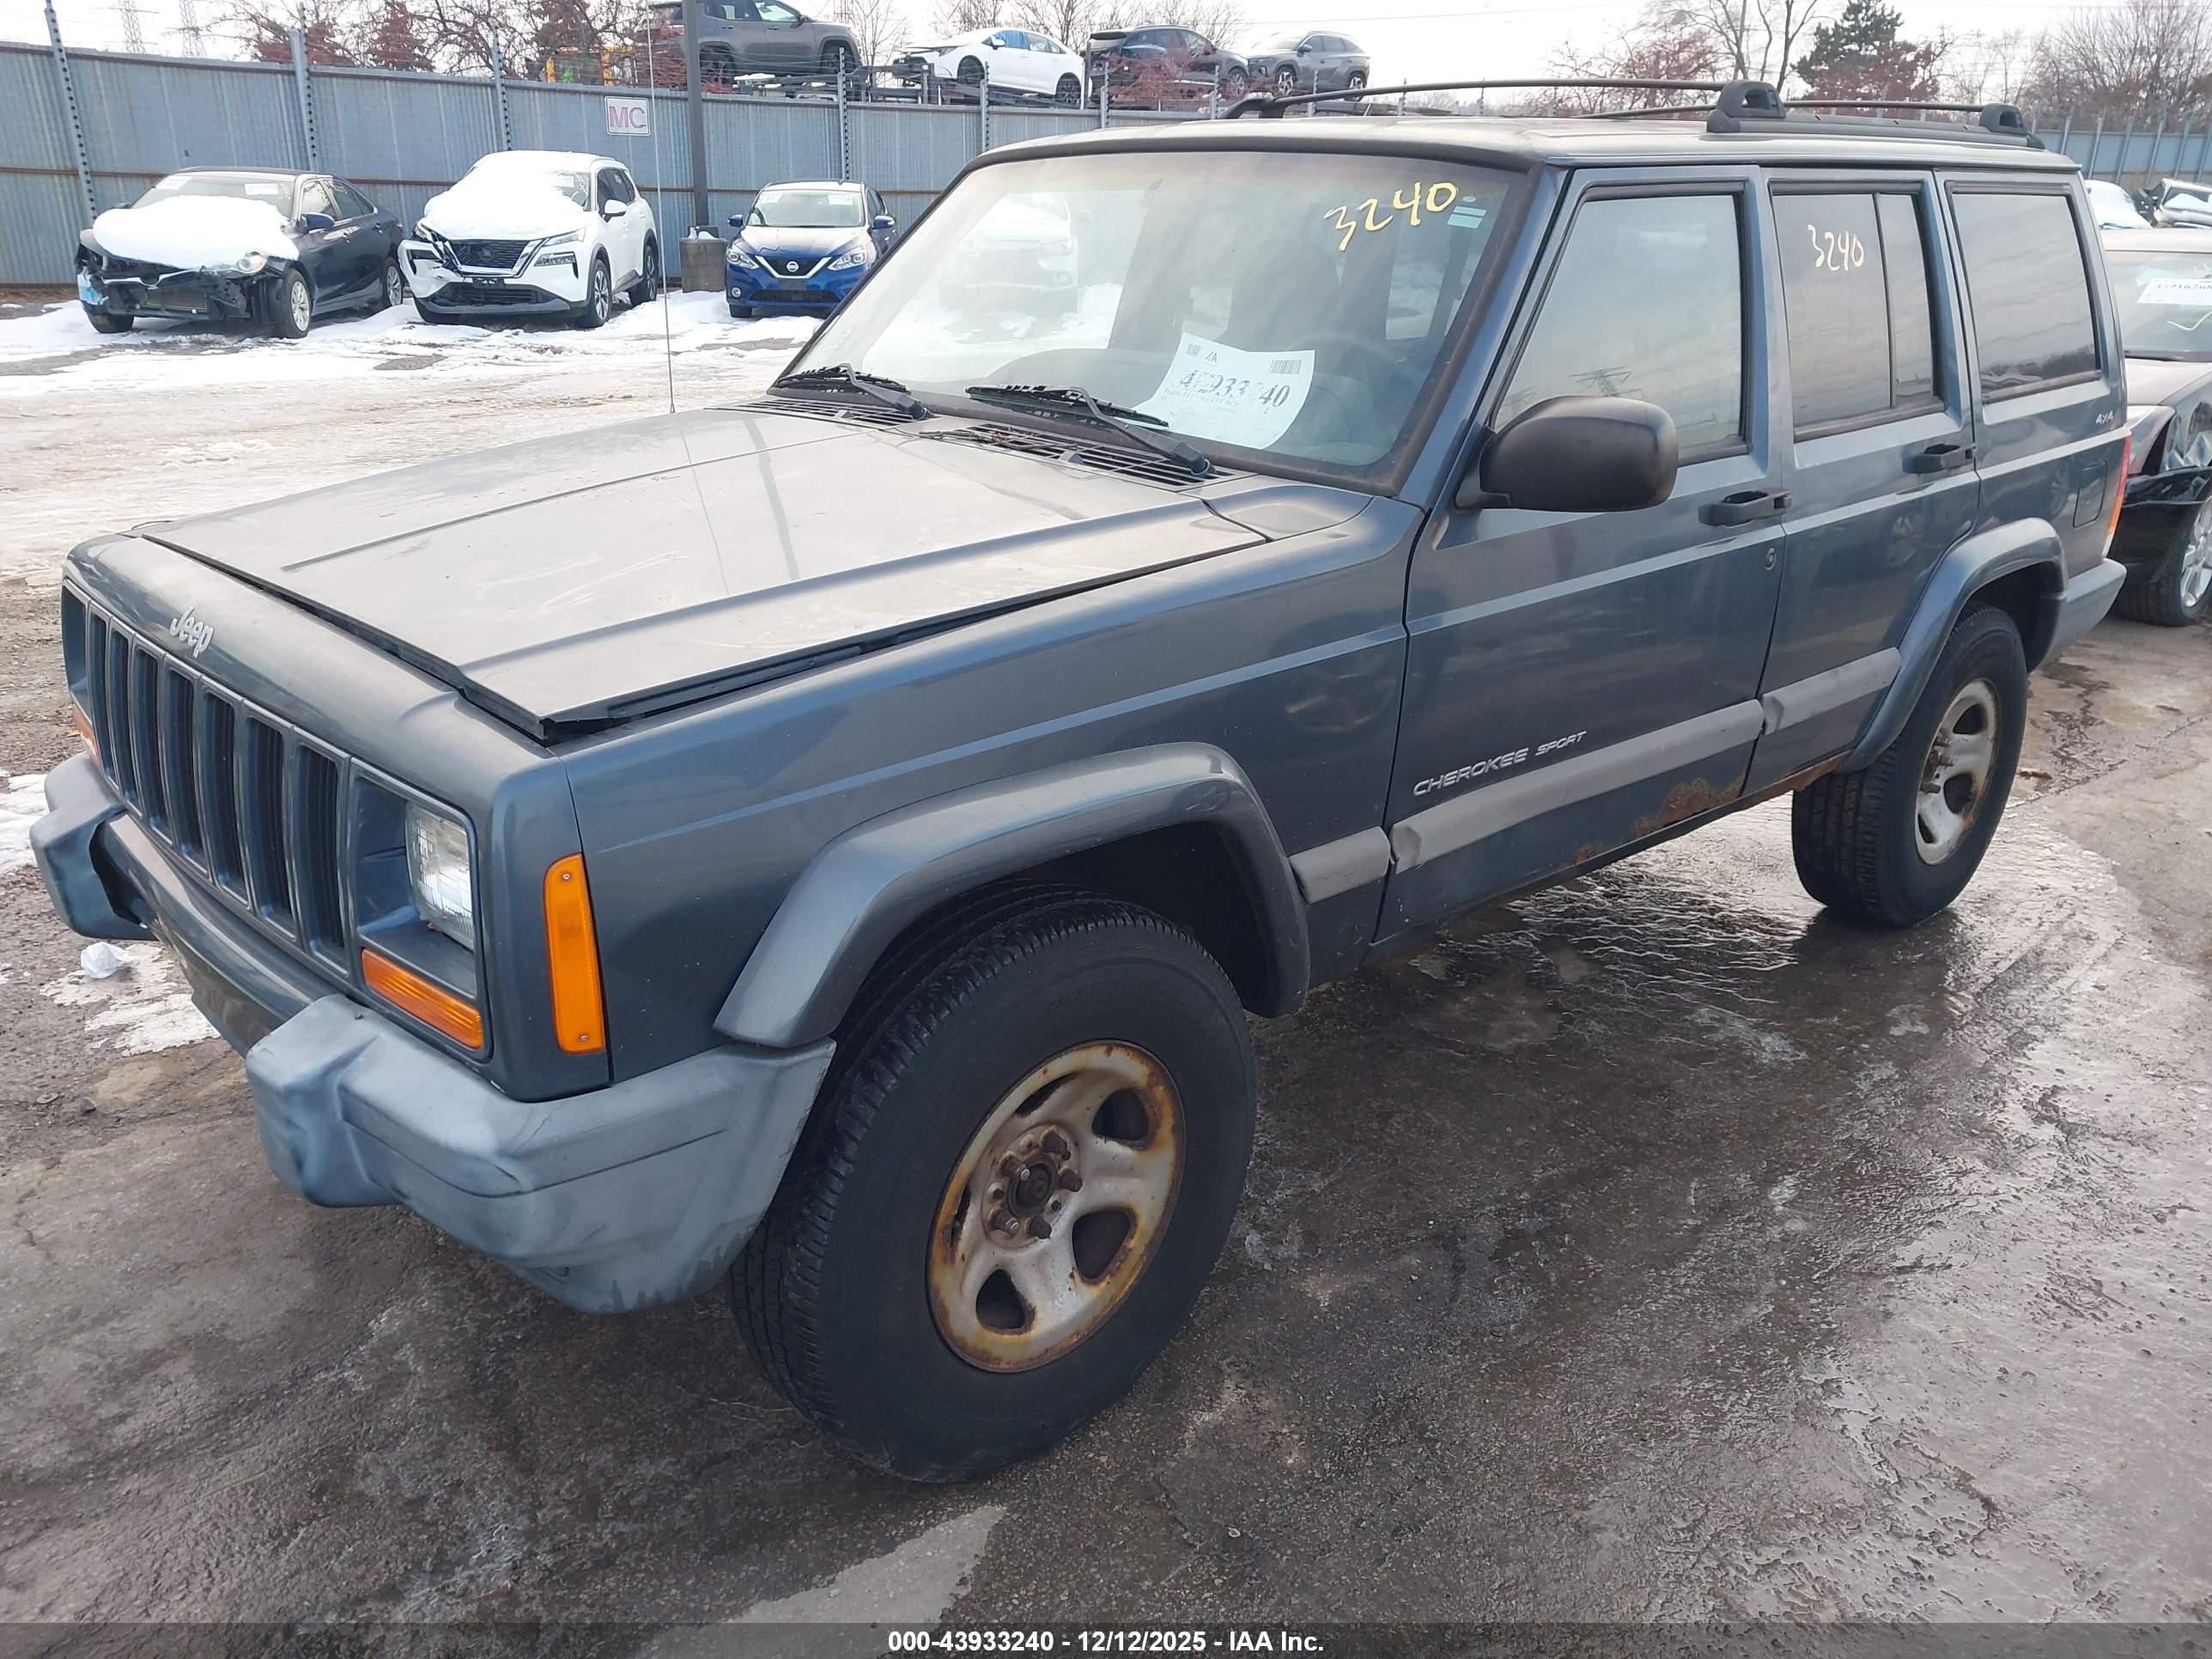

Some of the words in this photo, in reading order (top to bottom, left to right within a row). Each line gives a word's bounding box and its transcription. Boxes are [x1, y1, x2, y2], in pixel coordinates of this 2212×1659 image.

[609, 106, 647, 129] MC
[1323, 181, 1458, 252] 3240
[1807, 223, 1864, 271] 3240
[169, 605, 214, 659] Jeep
[1413, 747, 1529, 797] CHEROKEE
[1534, 730, 1588, 757] SPORT
